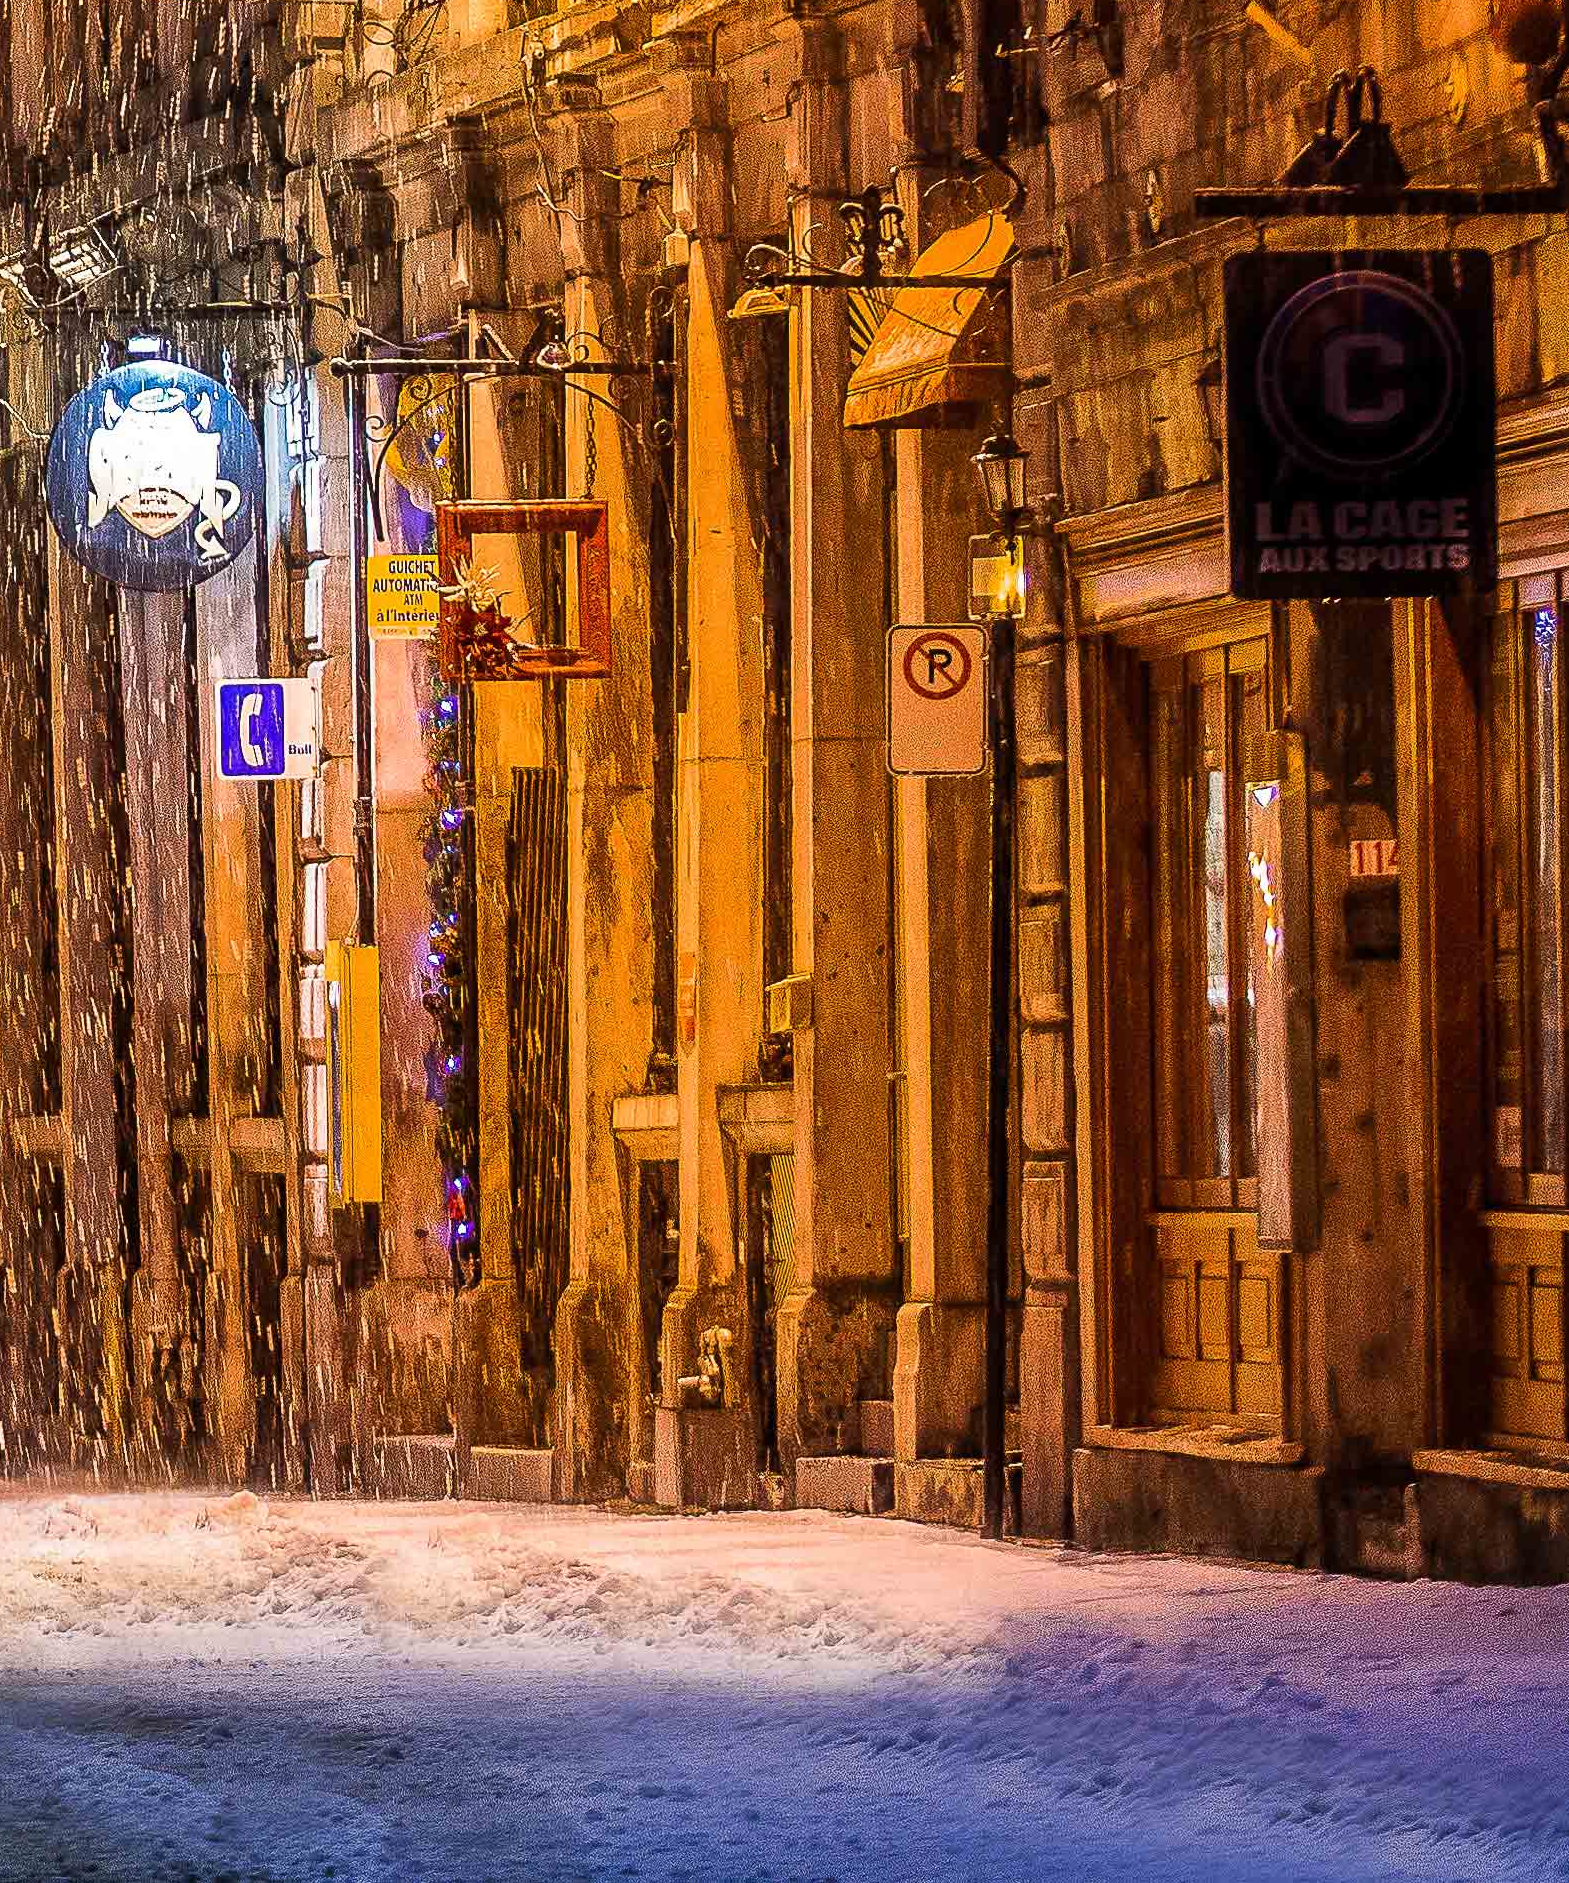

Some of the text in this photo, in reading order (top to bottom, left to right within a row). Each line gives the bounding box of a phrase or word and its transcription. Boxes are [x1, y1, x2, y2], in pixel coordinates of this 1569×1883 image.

[1324, 333, 1405, 422] C
[1255, 498, 1470, 542] LA CAGE
[388, 560, 436, 574] GUICHET
[1260, 542, 1471, 574] AUX SPORTS
[404, 593, 423, 606] ATM
[376, 608, 384, 622] à
